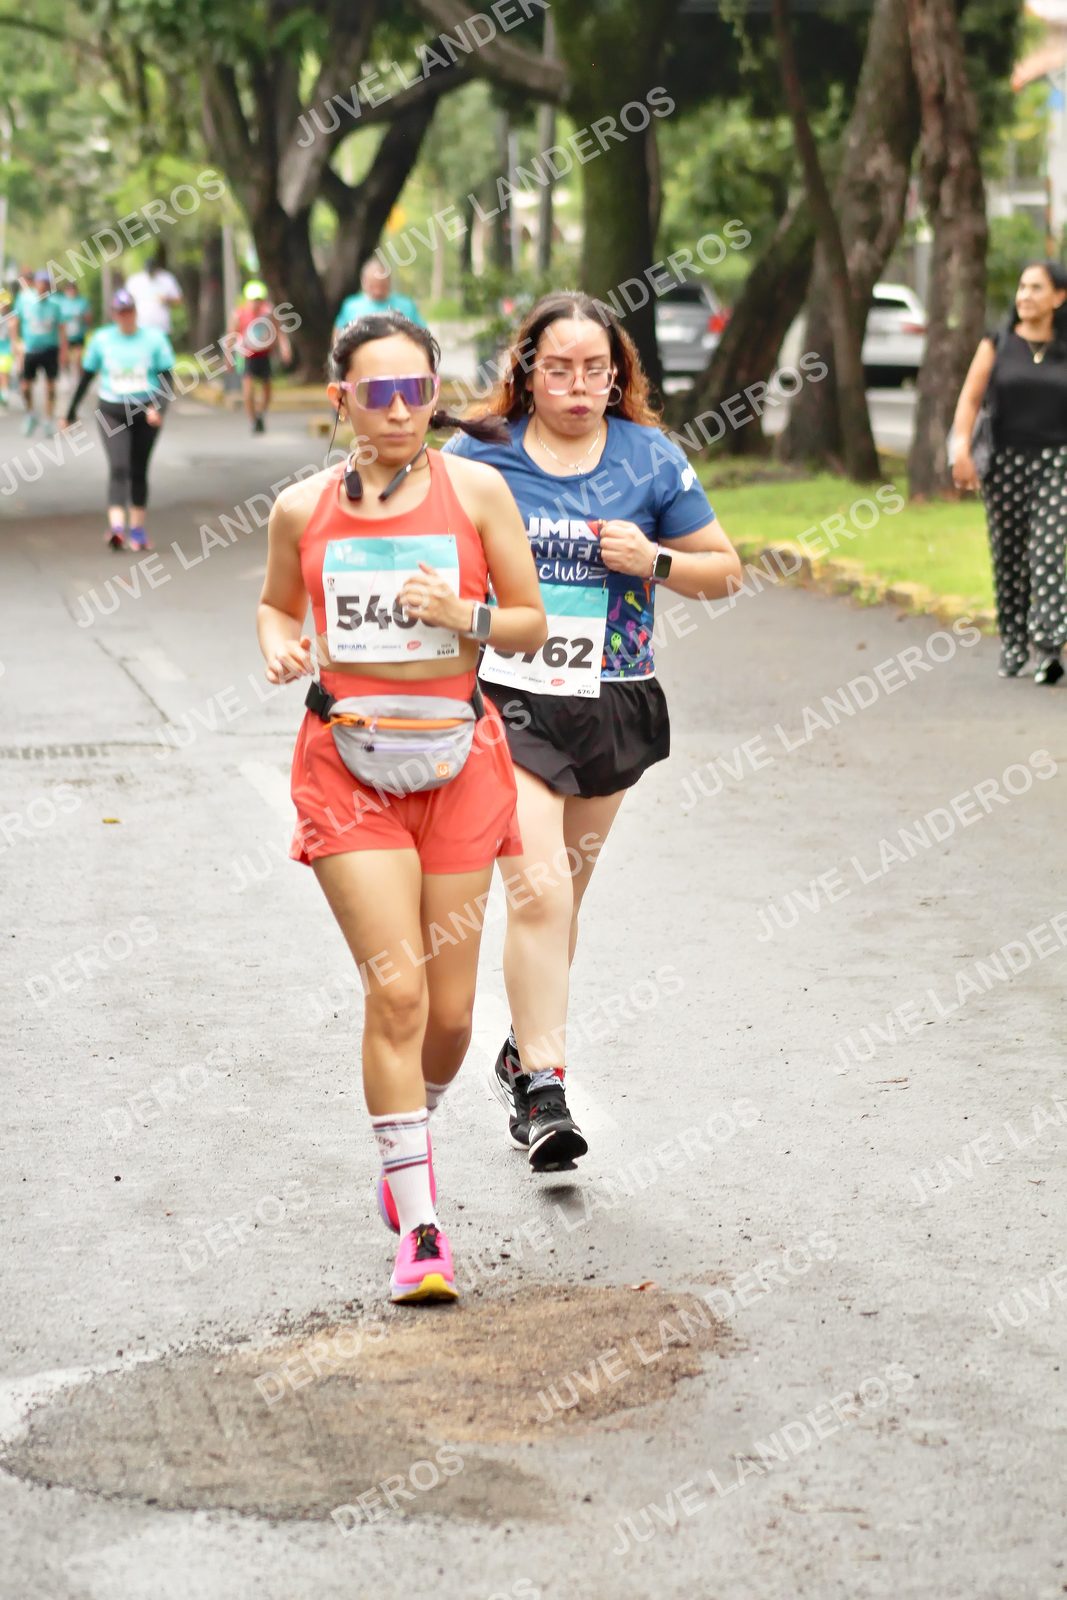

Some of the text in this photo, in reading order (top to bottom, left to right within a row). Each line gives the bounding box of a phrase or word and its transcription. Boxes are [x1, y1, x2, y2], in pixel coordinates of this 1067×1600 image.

[539, 561, 588, 581] club
[337, 595, 444, 630] 540
[494, 636, 594, 669] 62
